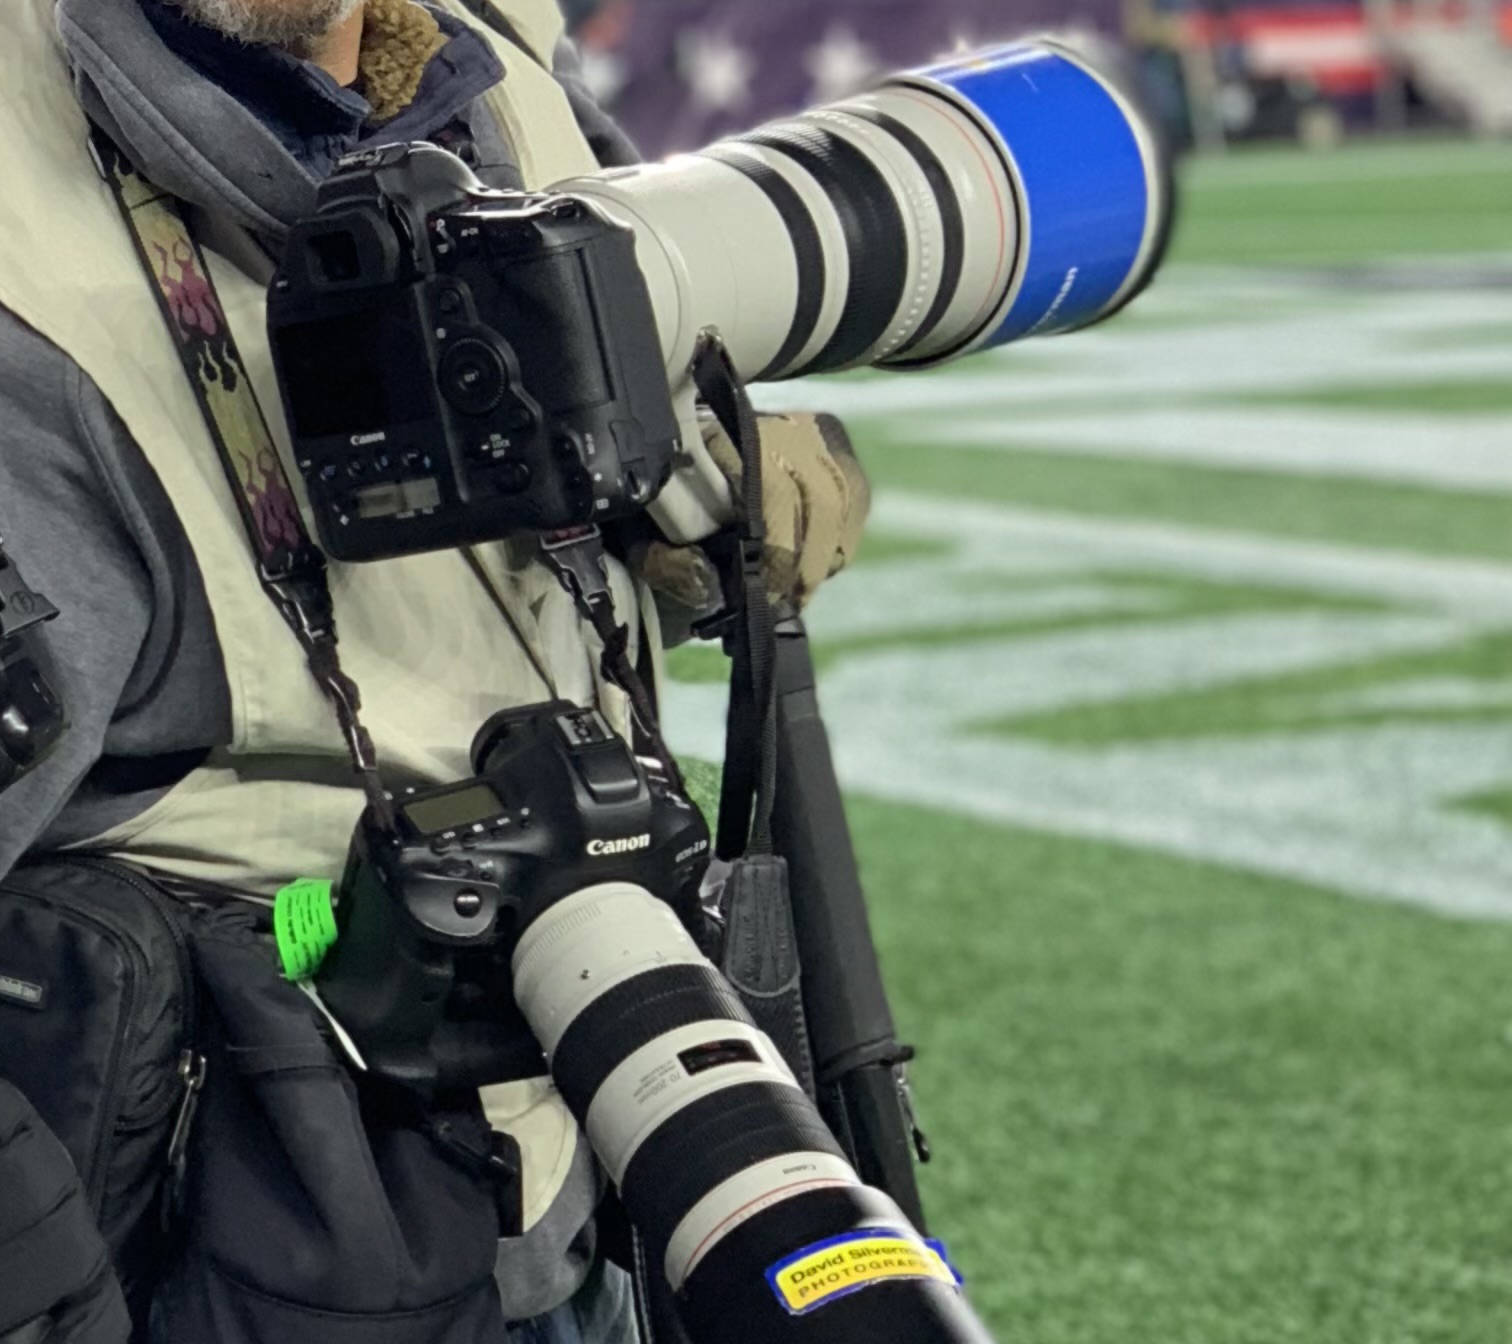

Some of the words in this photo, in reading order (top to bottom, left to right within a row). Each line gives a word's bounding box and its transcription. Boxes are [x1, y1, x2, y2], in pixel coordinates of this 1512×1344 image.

[350, 431, 386, 446] Canon
[586, 833, 651, 856] Canon
[790, 1253, 845, 1284] David
